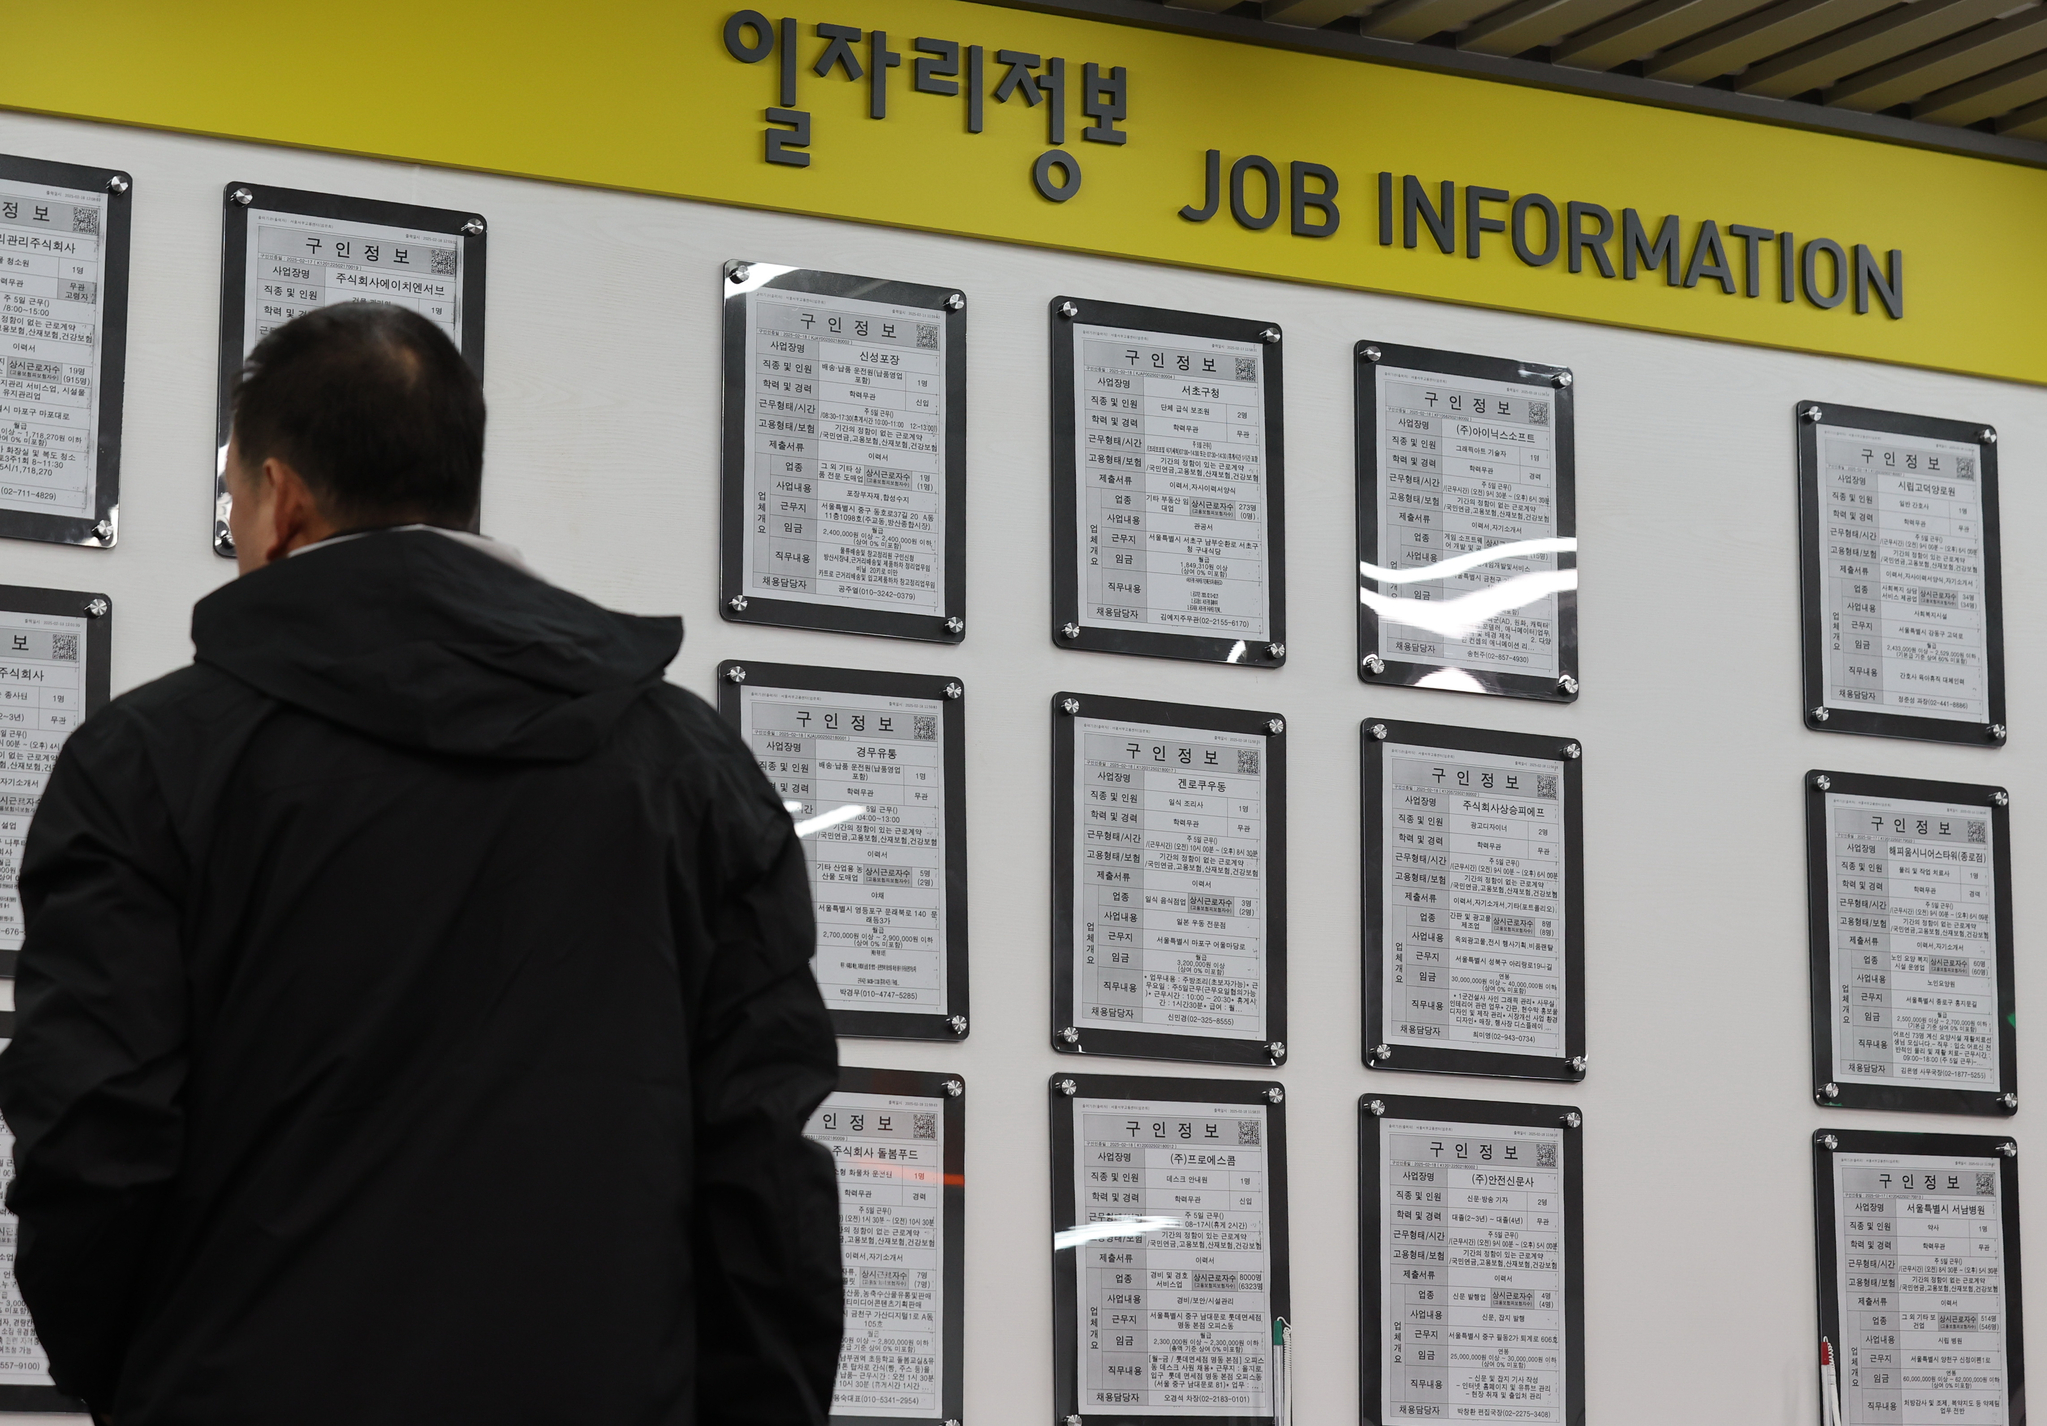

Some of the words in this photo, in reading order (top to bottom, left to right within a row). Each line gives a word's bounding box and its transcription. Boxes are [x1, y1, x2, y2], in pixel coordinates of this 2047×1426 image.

[724, 8, 1128, 204] 일자리정보
[1180, 150, 1340, 240] JOB
[1379, 170, 1906, 320] INFORMATION
[272, 265, 310, 280] 사업장명
[69, 282, 86, 292] 무관
[335, 272, 445, 296] 주식회사에이치엔서브
[65, 291, 89, 302] 고령자
[264, 284, 283, 297] 직종
[286, 287, 295, 298] 및
[299, 289, 318, 301] 인원
[431, 307, 443, 316] 1명
[12, 342, 36, 353] 이력서
[770, 340, 805, 354] 사업장명
[859, 351, 900, 366] 신성포장
[762, 359, 781, 371] 직종
[783, 362, 792, 372] 및
[795, 363, 812, 375] 인원
[917, 379, 928, 388] 1명
[1097, 377, 1131, 389] 사업장명
[1181, 385, 1220, 399] 서초구청
[758, 398, 816, 415] 근무형태/시간
[915, 399, 930, 408] 신입
[1160, 403, 1174, 412] 단체
[1175, 404, 1189, 414] 급식
[1190, 406, 1210, 416] 보조원
[13, 406, 37, 417] 마포구
[39, 409, 70, 421] 마포대로
[1237, 411, 1248, 420] 2명
[1398, 417, 1429, 431] 사업장명
[1236, 430, 1250, 439] 무관
[1456, 424, 1536, 444] (주)아이닉스소프트
[1455, 445, 1486, 455] 그래픽아트
[1487, 448, 1507, 458] 기술자
[1530, 454, 1540, 462] 1명
[1529, 472, 1541, 481] 경력
[1837, 474, 1866, 486] 사업장명
[1898, 481, 1956, 497] 시립고덕양로원
[1389, 491, 1440, 507] 고용형태/보험
[1832, 491, 1847, 502] 직종
[1848, 493, 1856, 502] 및
[1858, 494, 1873, 505] 인원
[1191, 499, 1234, 512] 상시근로자수
[1899, 500, 1911, 508] 일반
[1912, 501, 1930, 510] 간호사
[1958, 507, 1968, 515] 1명
[1193, 522, 1213, 531] 관공서
[1471, 521, 1522, 535] 이력서,자기소개서
[1958, 524, 1970, 533] 무관
[1413, 532, 1430, 543] 업종
[1115, 553, 1134, 565] 임금
[762, 576, 807, 590] 채용담당자
[1914, 610, 1948, 620] 사회복지시설
[1851, 620, 1873, 631] 근무지
[1395, 641, 1436, 654] 채용담당자
[53, 694, 65, 704] 1명
[50, 715, 67, 725] 무관
[766, 740, 801, 753] 사업장명
[856, 746, 897, 760] 경무유통
[780, 762, 788, 772] 및
[791, 762, 809, 774] 인원
[1177, 778, 1227, 793] 겐로쿠우동
[914, 792, 929, 801] 무관
[1404, 795, 1437, 808] 사업장명
[1168, 798, 1182, 807] 일식
[1183, 800, 1204, 809] 조리사
[1238, 805, 1249, 814] 1명
[1462, 799, 1545, 818] 주식회사상승피에프
[1090, 809, 1107, 821] 학력
[1110, 811, 1118, 822] 및
[1121, 813, 1138, 824] 경력
[1470, 821, 1508, 833] 광고디자이너
[1538, 828, 1548, 837] 2명
[1846, 843, 1876, 855] 사업장명
[1096, 870, 1131, 883] 제출서류
[1912, 867, 1918, 875] 및
[1932, 869, 1950, 878] 치료사
[1969, 890, 1981, 898] 경력
[1449, 911, 1463, 921] 간판
[1464, 913, 1471, 921] 및
[1472, 913, 1492, 923] 광고물
[1176, 918, 1190, 927] 일본
[1191, 919, 1205, 928] 우동
[1206, 920, 1226, 930] 전문점
[1411, 931, 1444, 943] 사업내용
[1927, 979, 1956, 988] 노인요양원
[1411, 999, 1444, 1012] 직무내용
[1905, 996, 1935, 1005] 서울특별시
[1936, 998, 1953, 1006] 종로구
[1848, 1062, 1886, 1074] 채용담당자
[831, 1145, 874, 1159] 주식회사
[877, 1147, 919, 1161] 돌봄푸드
[1097, 1151, 1131, 1163] 사업장명
[1170, 1153, 1236, 1167] (주)프로에스콤
[1166, 1174, 1186, 1183] 데스크
[1188, 1175, 1208, 1184] 안내원
[1240, 1177, 1251, 1186] 1명
[1402, 1171, 1435, 1182] 사업장명
[1471, 1173, 1535, 1188] (주)안전신문사
[844, 1188, 872, 1199] 학력무관
[912, 1192, 926, 1201] 경력
[1239, 1197, 1253, 1206] 신입
[1495, 1196, 1509, 1204] 기자
[1537, 1198, 1548, 1207] 2명
[1855, 1202, 1884, 1213] 사업장명
[1906, 1203, 1949, 1215] 서울특별시
[1952, 1204, 1985, 1216] 서남병원
[1849, 1221, 1865, 1231] 직종
[1866, 1221, 1874, 1231] 및
[1876, 1221, 1891, 1232] 인원
[1927, 1224, 1940, 1232] 약사
[1978, 1225, 1988, 1233] 1명
[1978, 1243, 1990, 1252] 무관
[845, 1251, 903, 1262] 이력서,자기소개서
[1393, 1249, 1445, 1262] 고용형태/보험
[1177, 1296, 1234, 1306] 경비/보안/시설관리
[1481, 1313, 1497, 1322] 신문,
[1498, 1314, 1511, 1322] 잡지
[1512, 1314, 1525, 1323] 발행
[1950, 1337, 1963, 1345] 병원
[1869, 1354, 1892, 1364] 근무지
[1108, 1365, 1143, 1377] 직무내용
